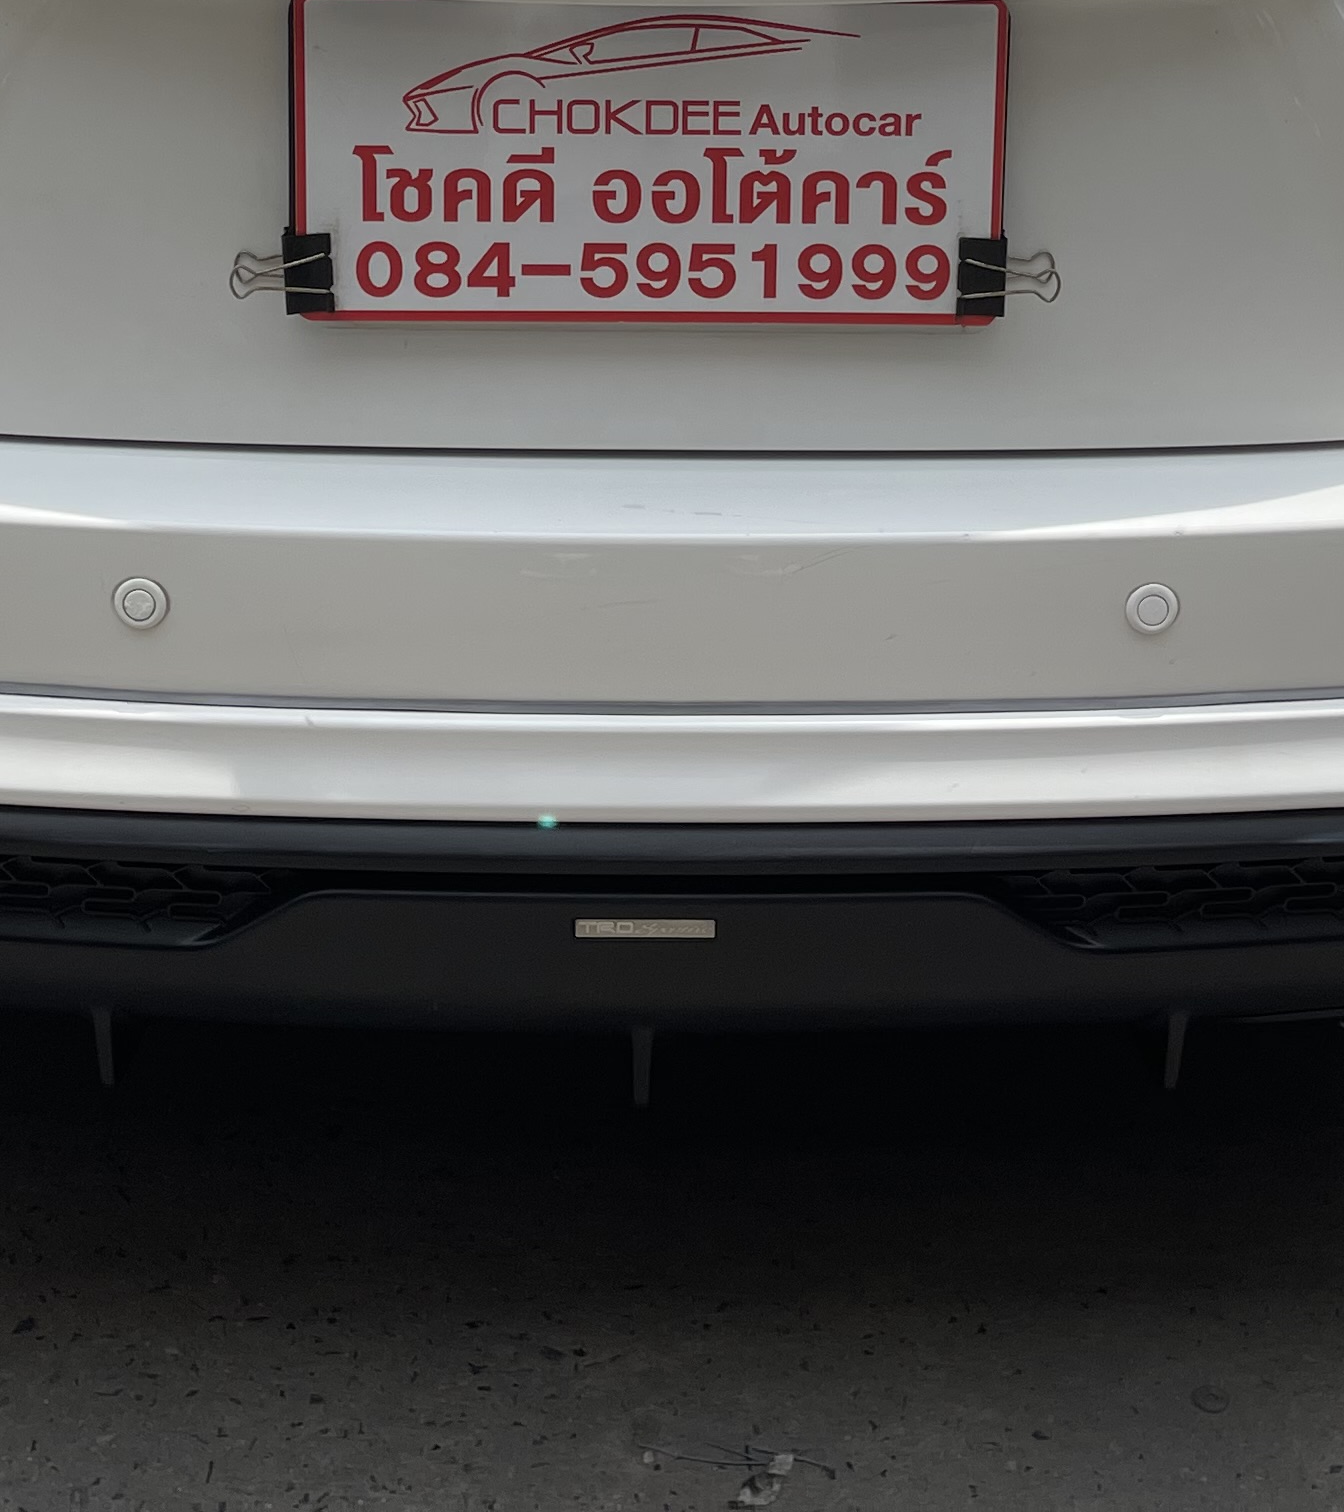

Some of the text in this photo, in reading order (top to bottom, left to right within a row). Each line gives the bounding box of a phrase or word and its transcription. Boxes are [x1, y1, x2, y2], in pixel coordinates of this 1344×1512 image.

[492, 98, 922, 137] CHOKDEE Autocar
[353, 145, 952, 226] โชคดี ออโต้คาร์
[355, 240, 952, 300] 084-5951999
[577, 920, 634, 934] TRD
